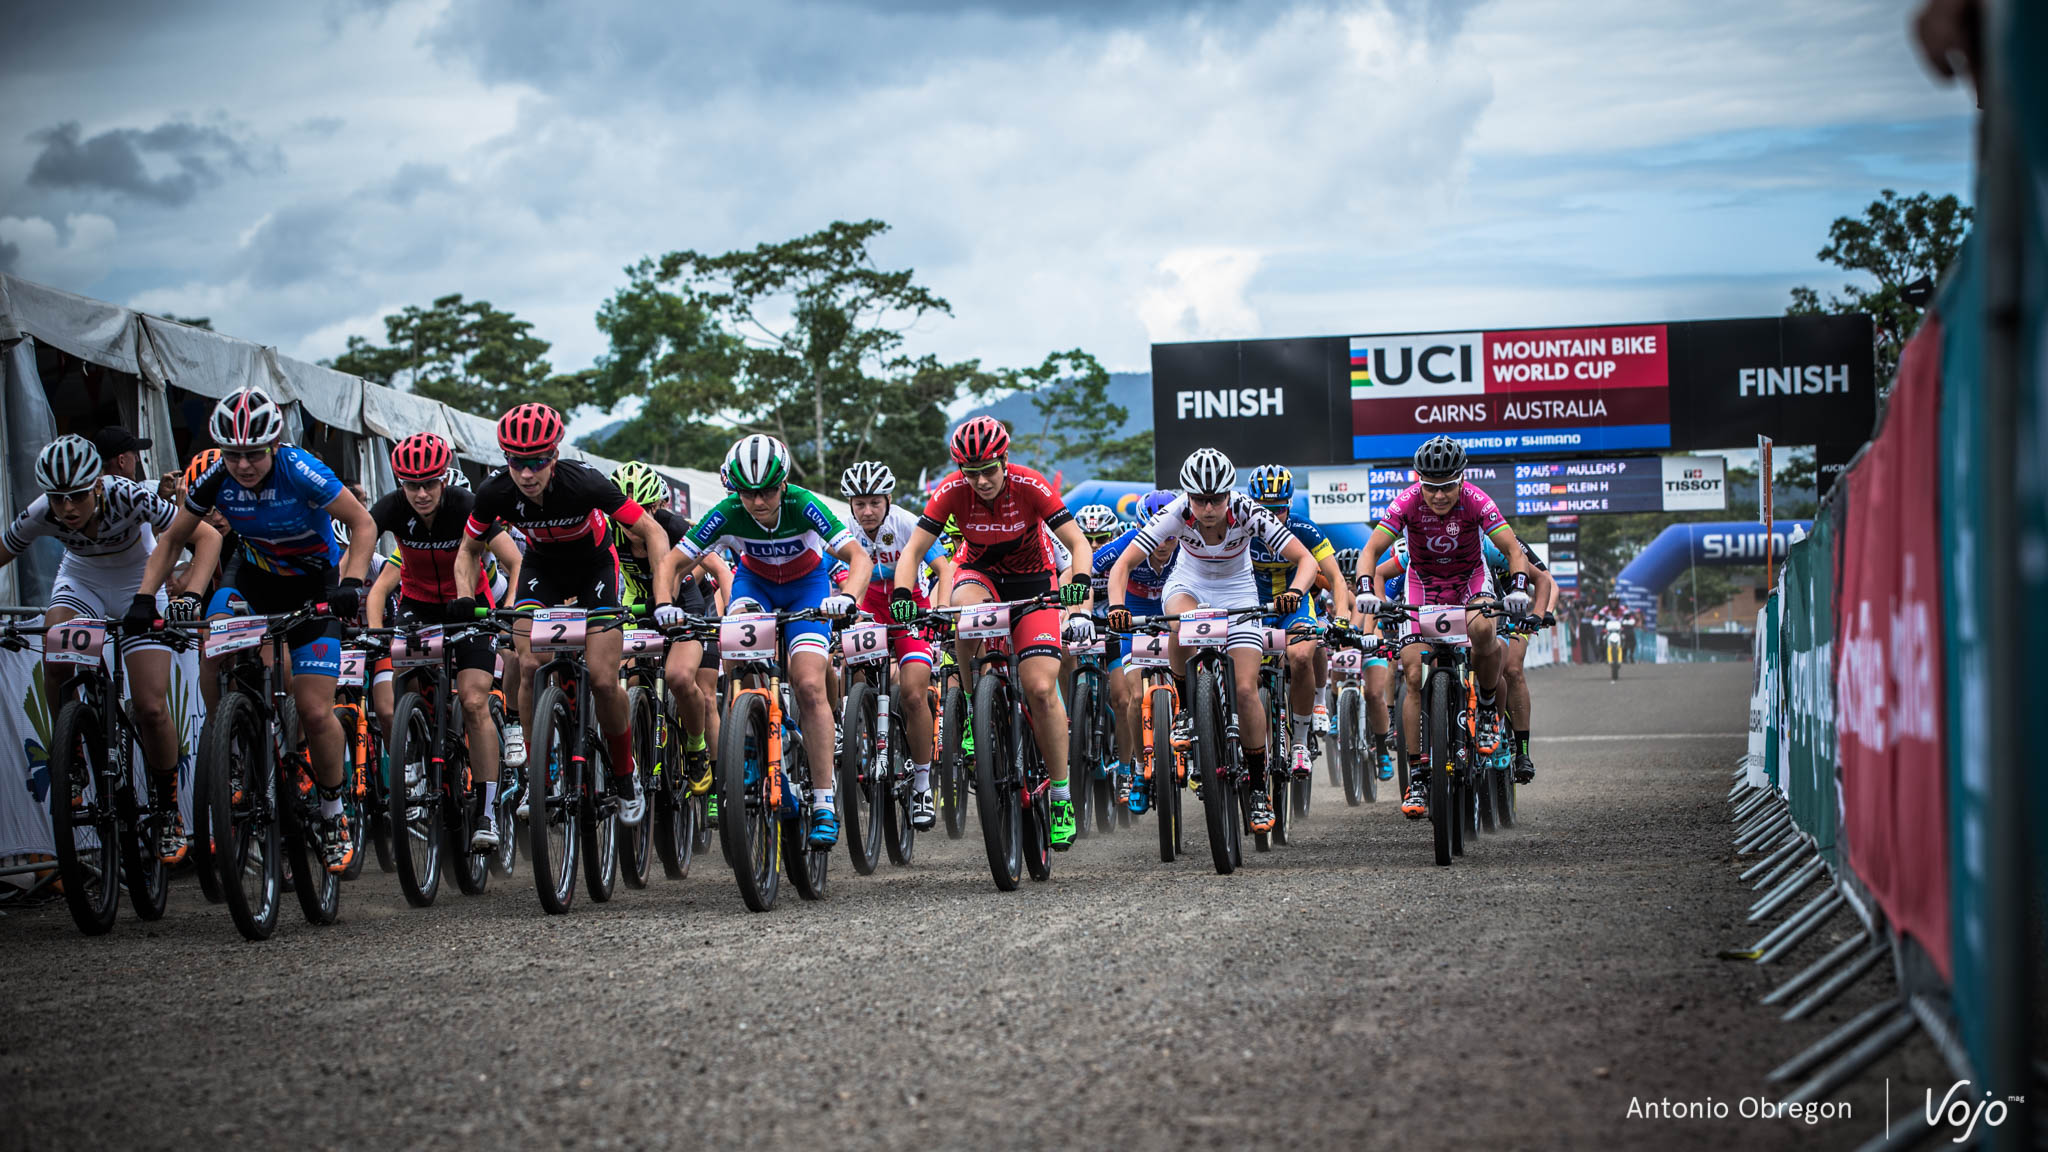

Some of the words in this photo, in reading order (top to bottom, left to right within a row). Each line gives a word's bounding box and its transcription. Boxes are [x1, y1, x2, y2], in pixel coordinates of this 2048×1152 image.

[1493, 338, 1608, 360] MOUNTAIN
[1611, 335, 1657, 355] BIKE
[1374, 345, 1472, 386] UCI
[1493, 362, 1570, 383] WORLD
[1573, 361, 1617, 380] CUP
[1739, 364, 1850, 397] FINISH
[1176, 387, 1284, 420] FINISH
[1414, 402, 1487, 424] CAIRNS
[1503, 399, 1608, 421] AUSTRALIA
[1505, 437, 1518, 447] BY
[1521, 434, 1581, 447] SHIMANO
[295, 460, 328, 488] UNIOR
[1516, 466, 1530, 479] 29
[1531, 465, 1550, 477] AUS
[1567, 463, 1616, 475] MULLENS
[1619, 462, 1626, 474] P
[934, 477, 969, 502] FOC
[1517, 483, 1531, 496] 30
[1567, 481, 1599, 493] KLEIN
[1600, 480, 1609, 492] H
[1665, 479, 1722, 491] TISSOT
[1312, 493, 1366, 504] TISSOT
[1517, 501, 1531, 513] 31
[1567, 499, 1600, 511] HUCK
[1601, 498, 1608, 510] E
[517, 515, 584, 528] SPECIALIZED
[805, 506, 828, 534] LUNA
[966, 520, 1026, 532] FOCUS
[700, 516, 723, 544] LUNA
[1292, 521, 1322, 539] SCOTT
[1549, 533, 1577, 543] START
[1180, 535, 1247, 547] GHST
[1703, 532, 1787, 559] SHIM
[751, 544, 801, 556] LUNA
[873, 551, 901, 564] SSIA
[1096, 552, 1118, 567] LUNA
[213, 624, 227, 632] UCI
[972, 612, 998, 628] 13
[1435, 613, 1451, 634] 6
[551, 624, 567, 643] 2
[739, 624, 757, 647] 3
[1195, 623, 1211, 635] 8
[59, 629, 92, 651] 10
[851, 631, 877, 652] 18
[1147, 638, 1162, 656] 4
[300, 660, 339, 669] TREK
[1336, 654, 1357, 667] 49
[769, 721, 780, 740] 32
[1143, 715, 1152, 730] 32
